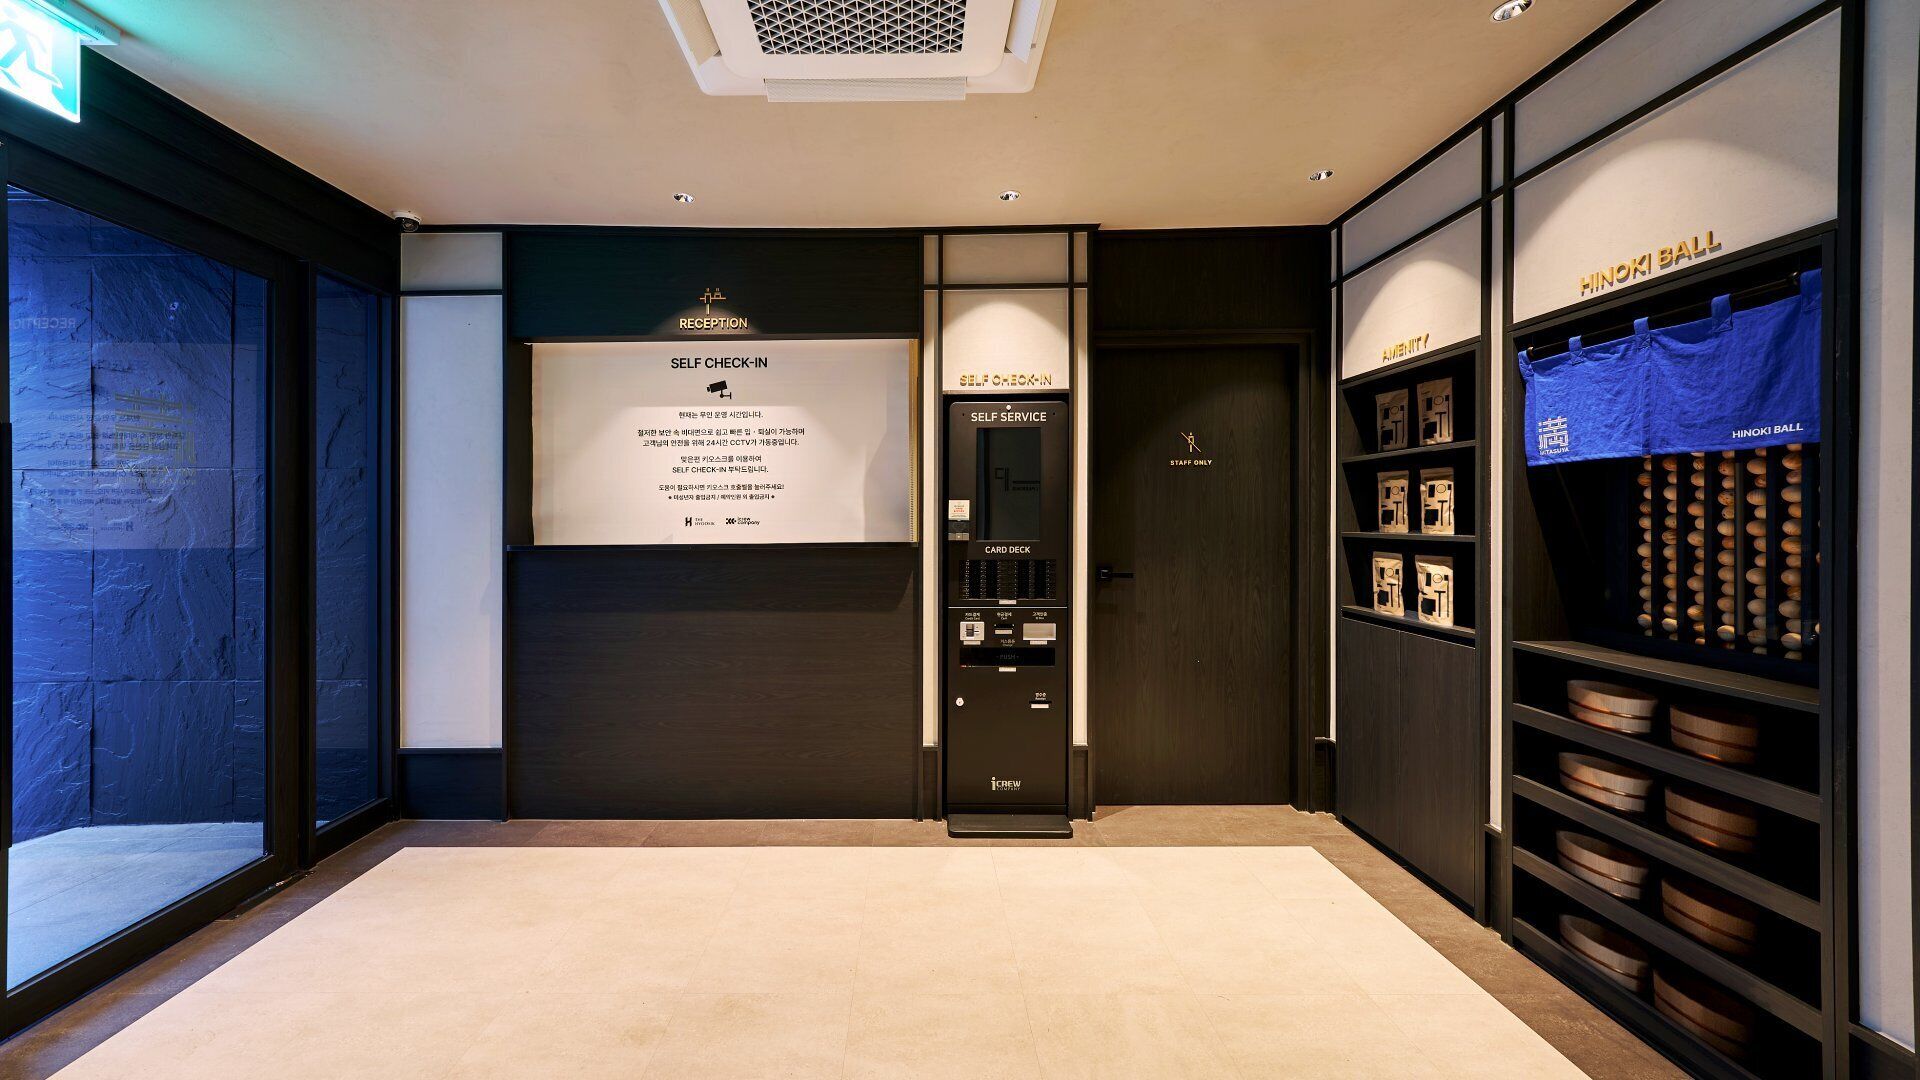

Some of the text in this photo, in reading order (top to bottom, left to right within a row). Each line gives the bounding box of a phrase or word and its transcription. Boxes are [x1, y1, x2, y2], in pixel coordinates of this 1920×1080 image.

[1580, 230, 1722, 296] HINOKI BALL
[679, 317, 749, 329] RECEPTION
[1382, 332, 1430, 363] AMENITY
[671, 357, 768, 369] SELF CHECK-IN
[960, 373, 1052, 386] SELF CHECK-IN
[678, 411, 764, 419] 현재는 무인 운영 시간입니다.
[971, 411, 1047, 422] SELF SERVICE
[658, 428, 672, 437] 보안
[681, 428, 714, 437] 비대면으로
[778, 428, 805, 436] 가능하며
[1732, 422, 1804, 439] HINOKI BALL
[642, 438, 800, 447] 고객님의 안전을 위해 24시간 CCTV가 가동중입니다.
[701, 455, 734, 463] 키오스크를
[735, 455, 762, 463] 이용하여
[727, 465, 769, 474] 부탁드립니다.
[985, 546, 1031, 554] CARD DECK
